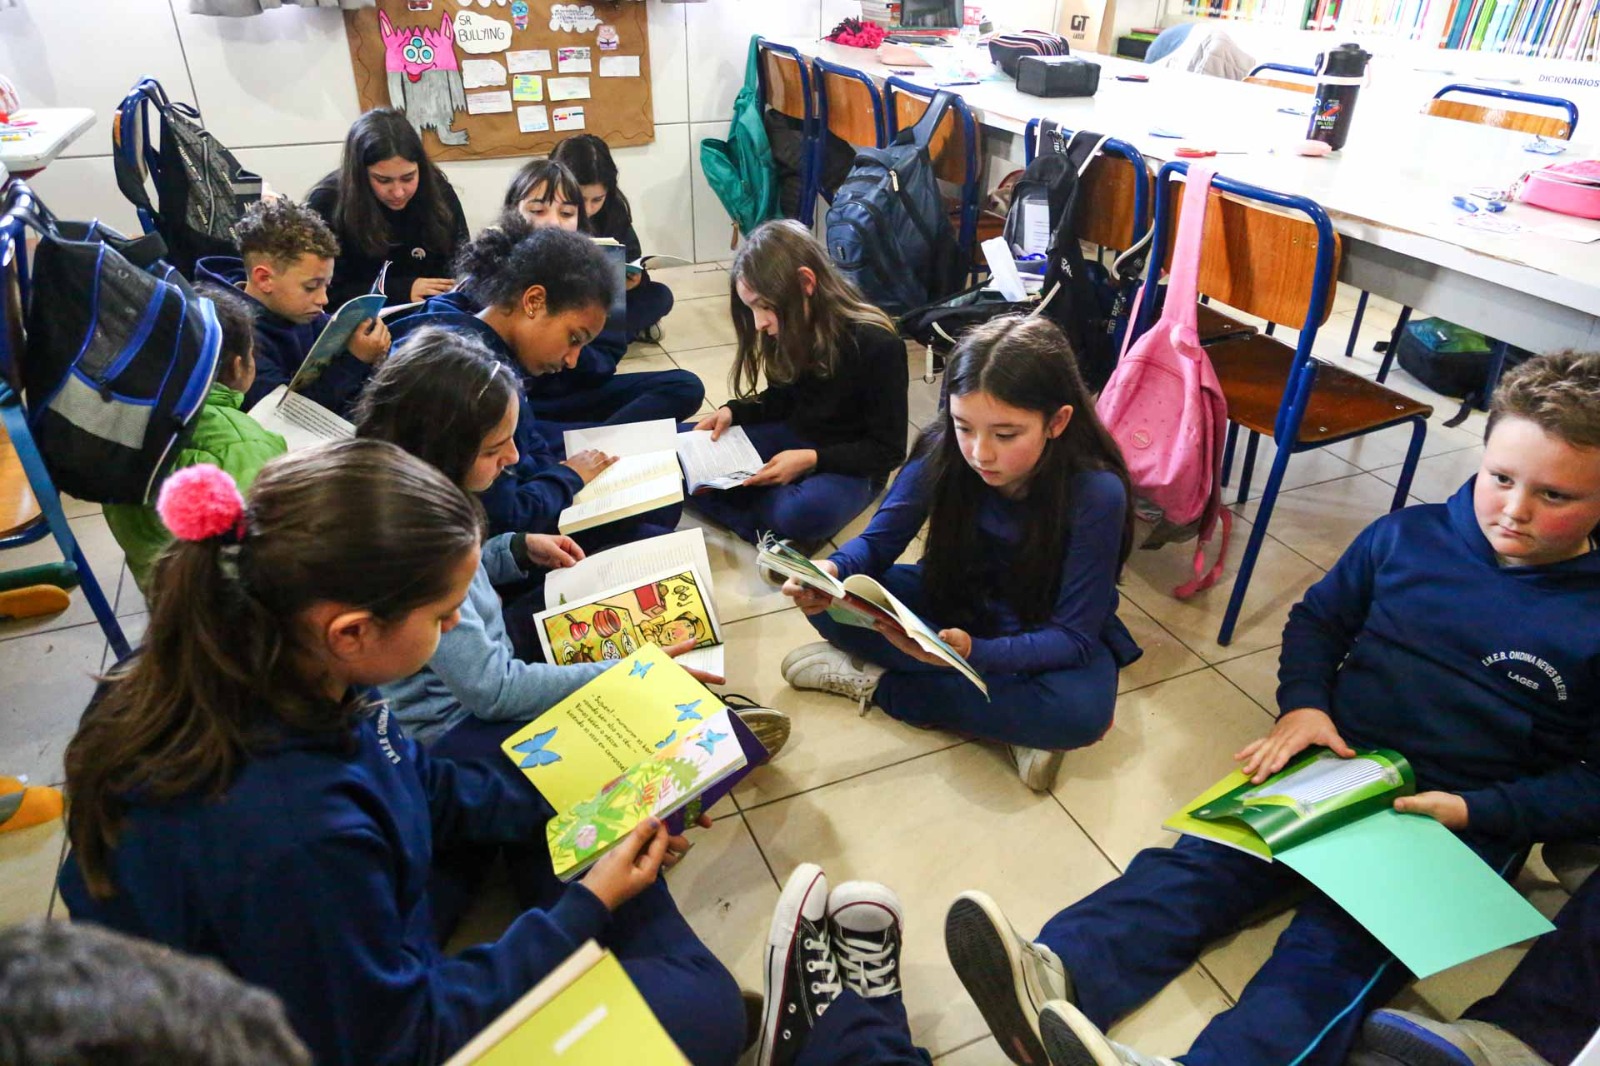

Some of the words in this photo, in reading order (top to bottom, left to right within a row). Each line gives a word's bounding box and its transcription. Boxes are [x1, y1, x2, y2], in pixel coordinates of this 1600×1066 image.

[458, 14, 473, 26] SR
[1070, 15, 1090, 31] GT
[458, 28, 505, 43] BULLYING
[1509, 650, 1537, 665] ONDINA
[1507, 671, 1540, 690] LAGES
